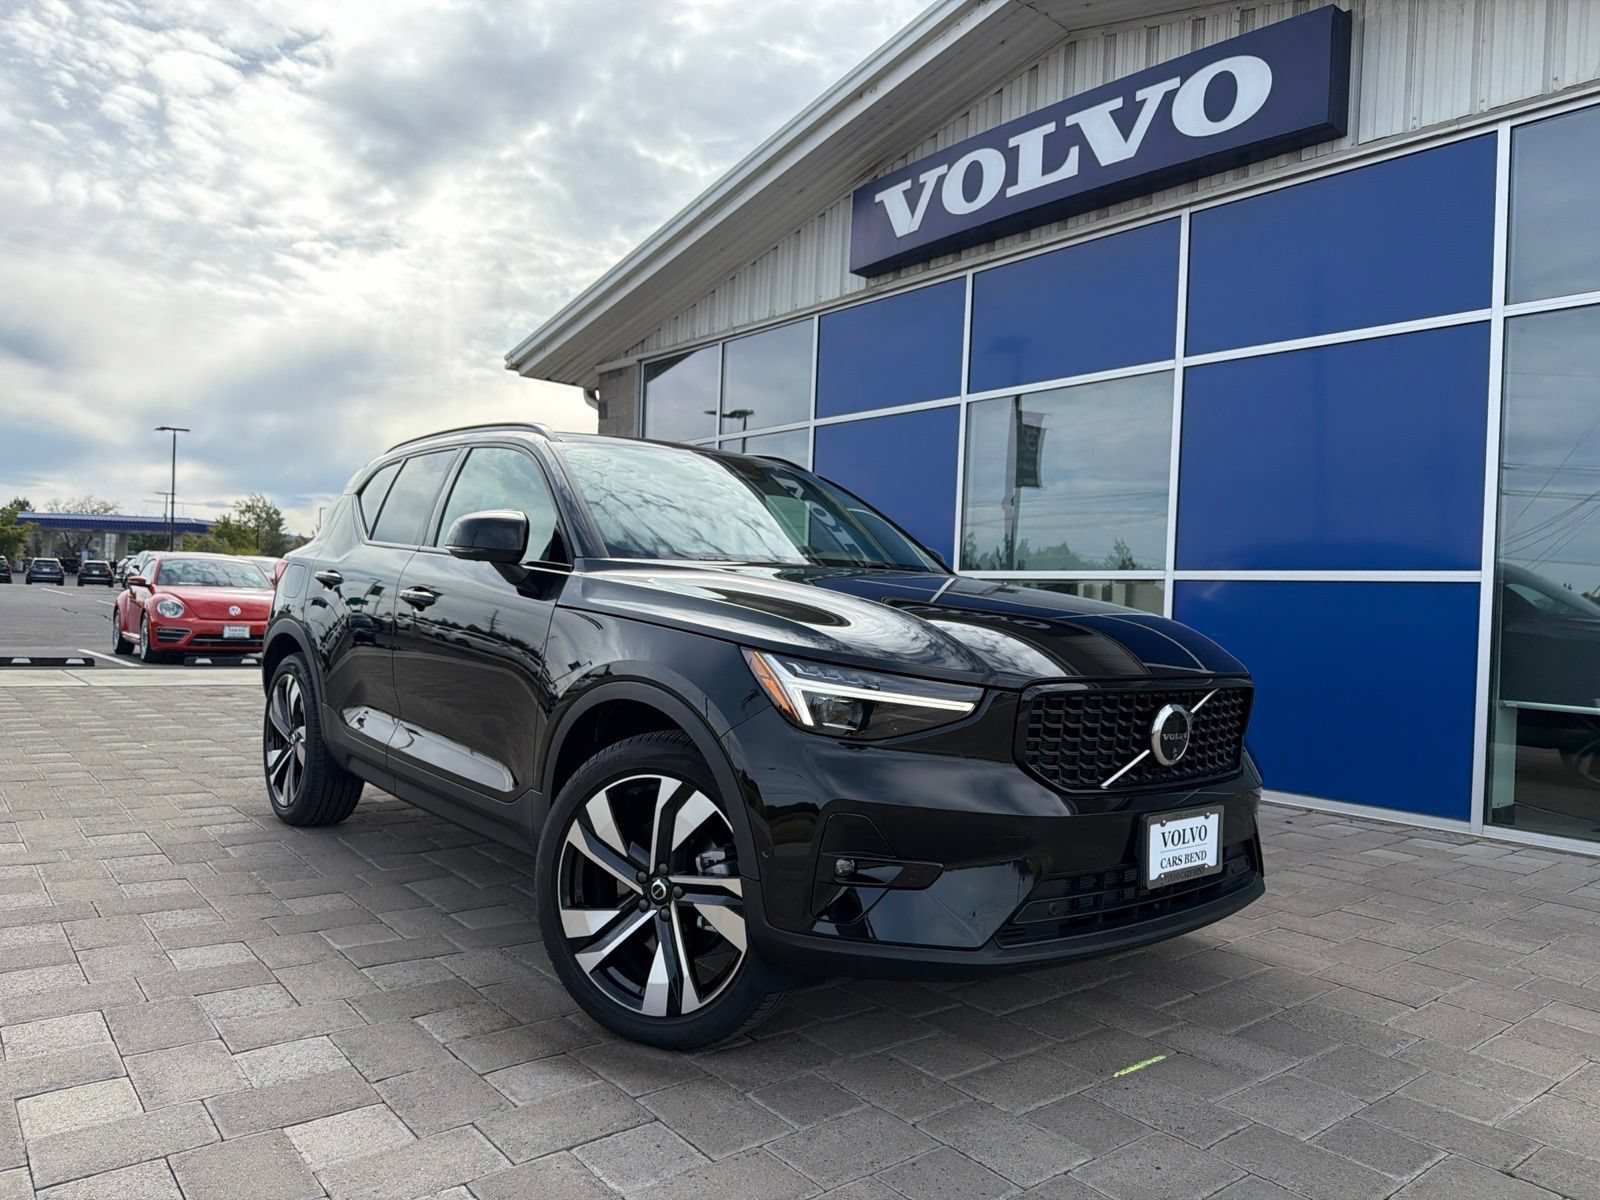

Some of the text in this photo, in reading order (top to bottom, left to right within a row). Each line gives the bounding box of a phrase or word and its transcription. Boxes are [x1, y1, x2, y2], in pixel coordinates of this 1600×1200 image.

[875, 55, 1272, 239] VOLVO
[1160, 825, 1208, 848] VOLVO
[1160, 850, 1207, 869] CARS BEND
